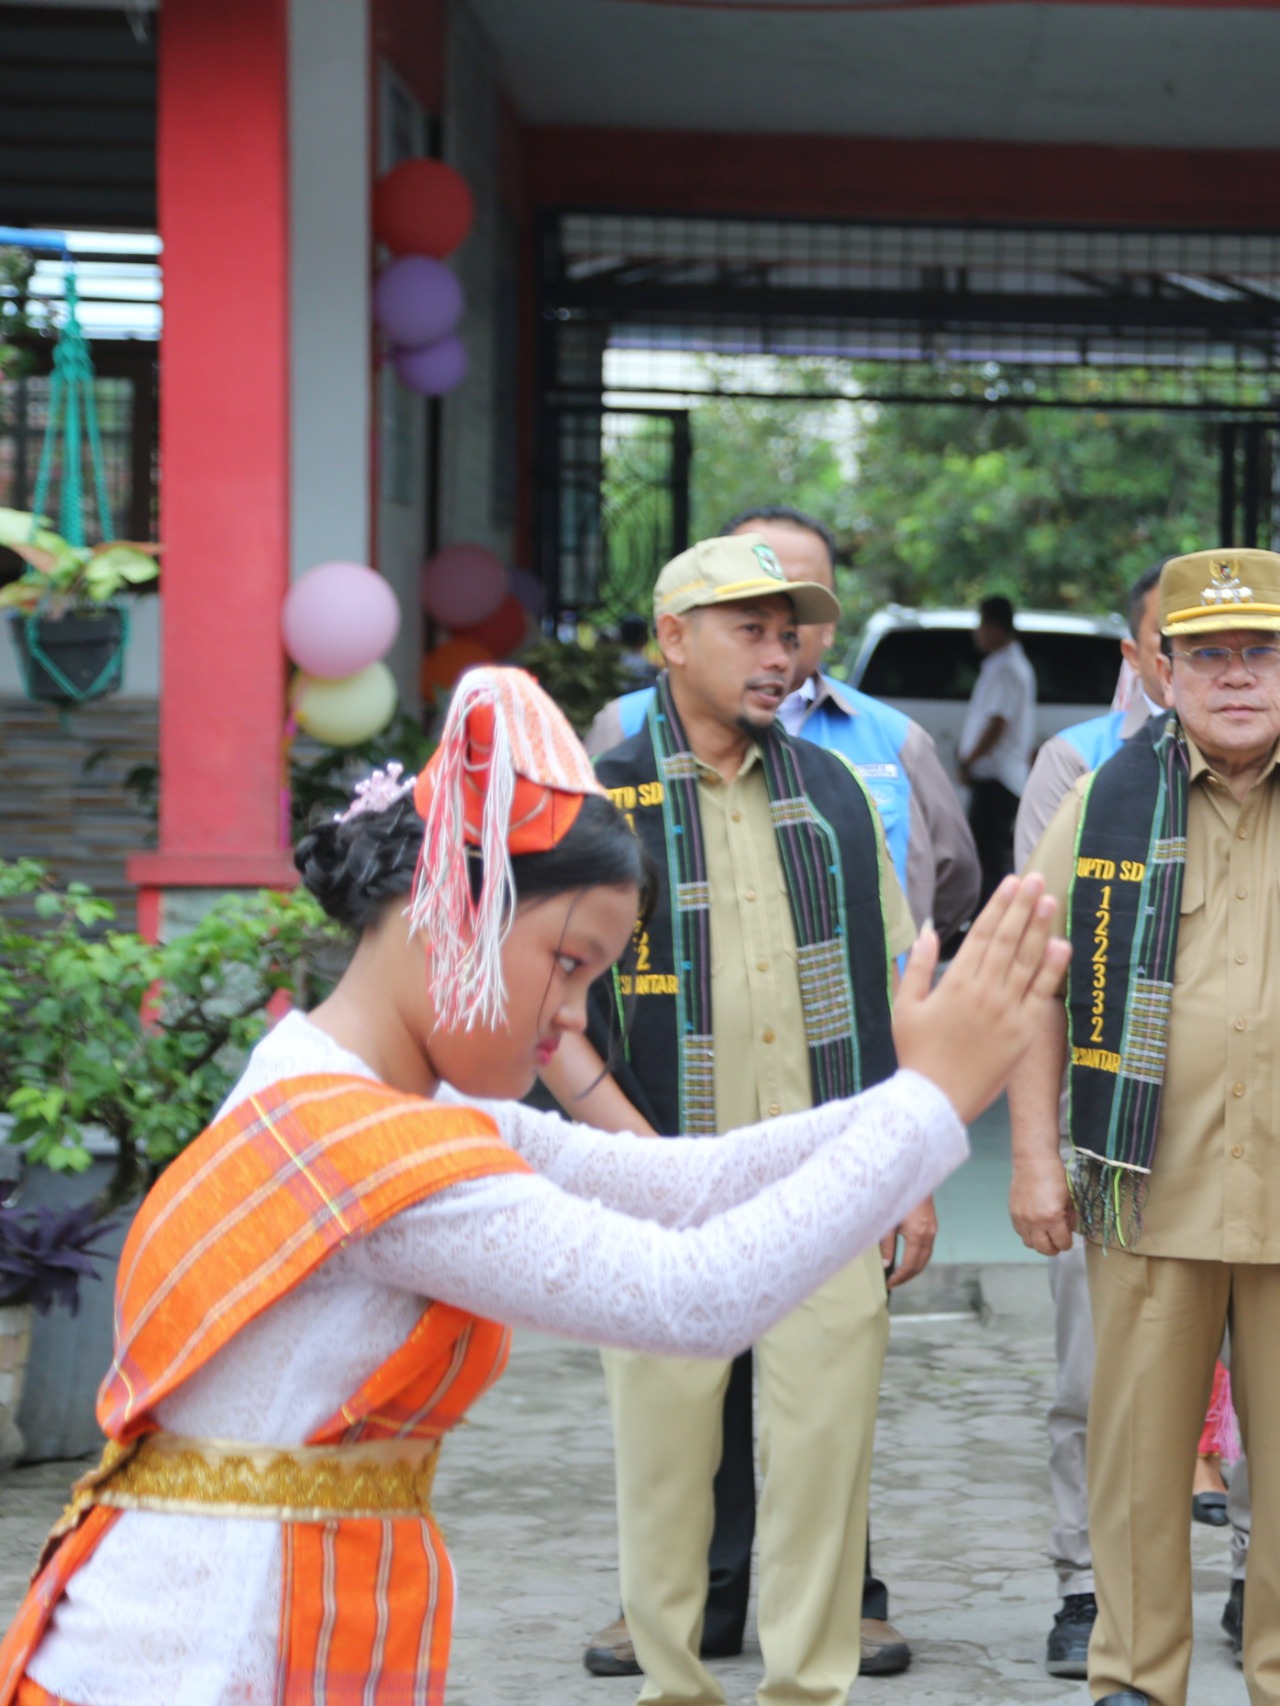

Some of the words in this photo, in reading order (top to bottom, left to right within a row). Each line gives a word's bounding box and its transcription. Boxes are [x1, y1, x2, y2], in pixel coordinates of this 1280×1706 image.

[638, 781, 665, 807] SD
[1076, 857, 1116, 880] UPTD
[1119, 860, 1146, 882] SD
